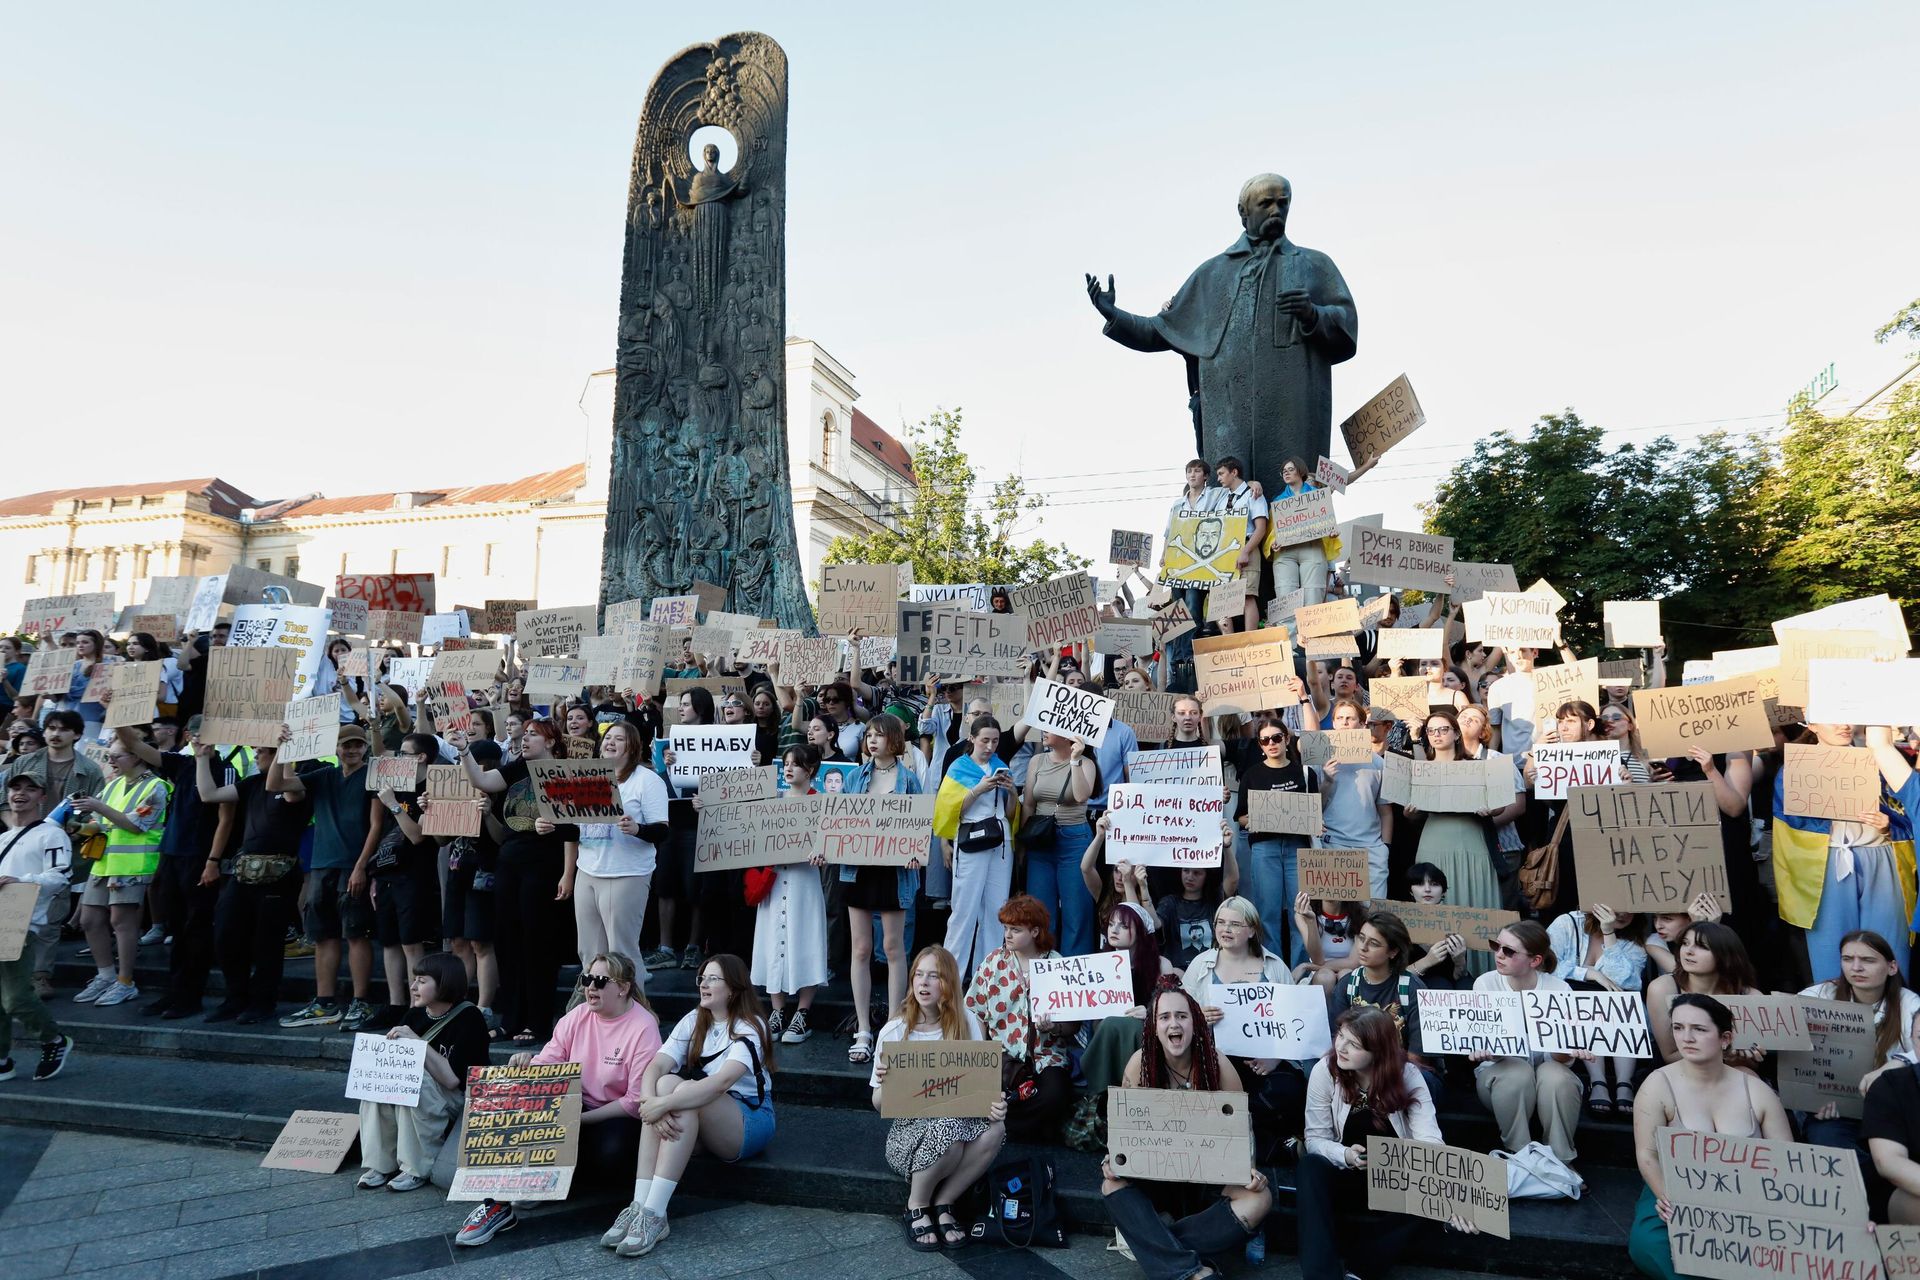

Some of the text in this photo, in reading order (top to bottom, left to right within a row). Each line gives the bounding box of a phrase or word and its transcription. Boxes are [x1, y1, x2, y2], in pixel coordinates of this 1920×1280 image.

[1361, 530, 1402, 551] РУСНЯ
[1012, 583, 1064, 608] СКІЛЬКИ
[1066, 573, 1088, 592] ЩЕ
[328, 600, 368, 615] УКРАЇНА
[1028, 590, 1085, 619] ПОТРІБНО
[1500, 598, 1552, 616] КОРУПЦІЇ
[331, 620, 359, 631] РОСІЯ
[523, 613, 557, 630] НАХУЯ
[820, 611, 889, 633] GUILTY!
[936, 613, 1001, 639] ГЕТЬ
[935, 638, 1027, 660] ВІД НАБУ
[442, 654, 476, 669] ВОВА
[1536, 665, 1585, 693] ВЛАДА
[1046, 683, 1106, 717] ГОЛОС
[1649, 689, 1756, 722] ЛІКВІДОВУЙТЕ
[1038, 709, 1100, 740] СТИХАТИ
[1052, 701, 1094, 726] НЕ МАЄ
[1678, 713, 1740, 739] СВОЇХ
[674, 737, 697, 752] НЕ
[1309, 731, 1364, 744] УКРАЇНА
[1303, 747, 1317, 759] НЕ
[673, 766, 689, 776] НЕ
[700, 768, 769, 793] ВЕРХОВНА
[1537, 762, 1614, 797] ЗРАДИ
[719, 782, 764, 800] ЗРАДА
[1790, 774, 1868, 792] НОМЕР
[702, 801, 808, 824] МЕНЕ ТРАХАЮТЬ
[824, 797, 876, 816] НАХУЯ
[1288, 793, 1319, 813] ГЕТЬ
[1580, 787, 1708, 834] ЧІПАТИ
[1786, 790, 1877, 819] ЗРАДИ
[701, 824, 725, 841] ЧАС
[761, 816, 798, 832] МНОЮ
[823, 833, 885, 859] ПРОТИ
[1300, 858, 1365, 869] ВАШІ ГРОШІ
[1305, 870, 1364, 888] ПАХНУТЬ
[1617, 864, 1727, 906] ТАБУ!!!
[1309, 887, 1358, 899] ЗРАДОЮ
[1223, 985, 1275, 1006] ЗНОВУ
[1253, 1002, 1275, 1018] 16
[1449, 1008, 1504, 1023] ГРОШЕЙ
[1527, 991, 1643, 1025] ЗАЇБАЛИ
[1422, 1020, 1508, 1035] ЛЮДИ ХОЧУТЬ
[1729, 1004, 1800, 1038] РАДА!
[371, 1040, 386, 1054] ЩО
[388, 1043, 416, 1056] СТОЯВ
[375, 1056, 417, 1069] МАЙДАН?
[887, 1050, 999, 1070] МЕНІ НЕ ОДНАКОВО
[921, 1076, 961, 1099] 12414
[1153, 1090, 1221, 1118] ЗРАДА
[468, 1110, 558, 1129] відчуттям,
[1161, 1119, 1187, 1132] ХТО
[465, 1131, 505, 1149] ніби
[518, 1124, 567, 1142] мене
[469, 1147, 558, 1165] тільки що
[1129, 1149, 1204, 1179] СТРАТИ
[1377, 1142, 1484, 1184] ЗАКЕНСЕЛЮ
[1669, 1130, 1845, 1178] ГІРШЕ, НІЖ
[1471, 1186, 1507, 1213] НАЇБУ?
[1674, 1165, 1847, 1216] ЧУЖІ ВОШІ,
[1669, 1204, 1844, 1254] МОЖУТЬ БУТИ
[1672, 1228, 1752, 1267] ТІЛЬКИ
[1751, 1244, 1787, 1273] СВОЇ
